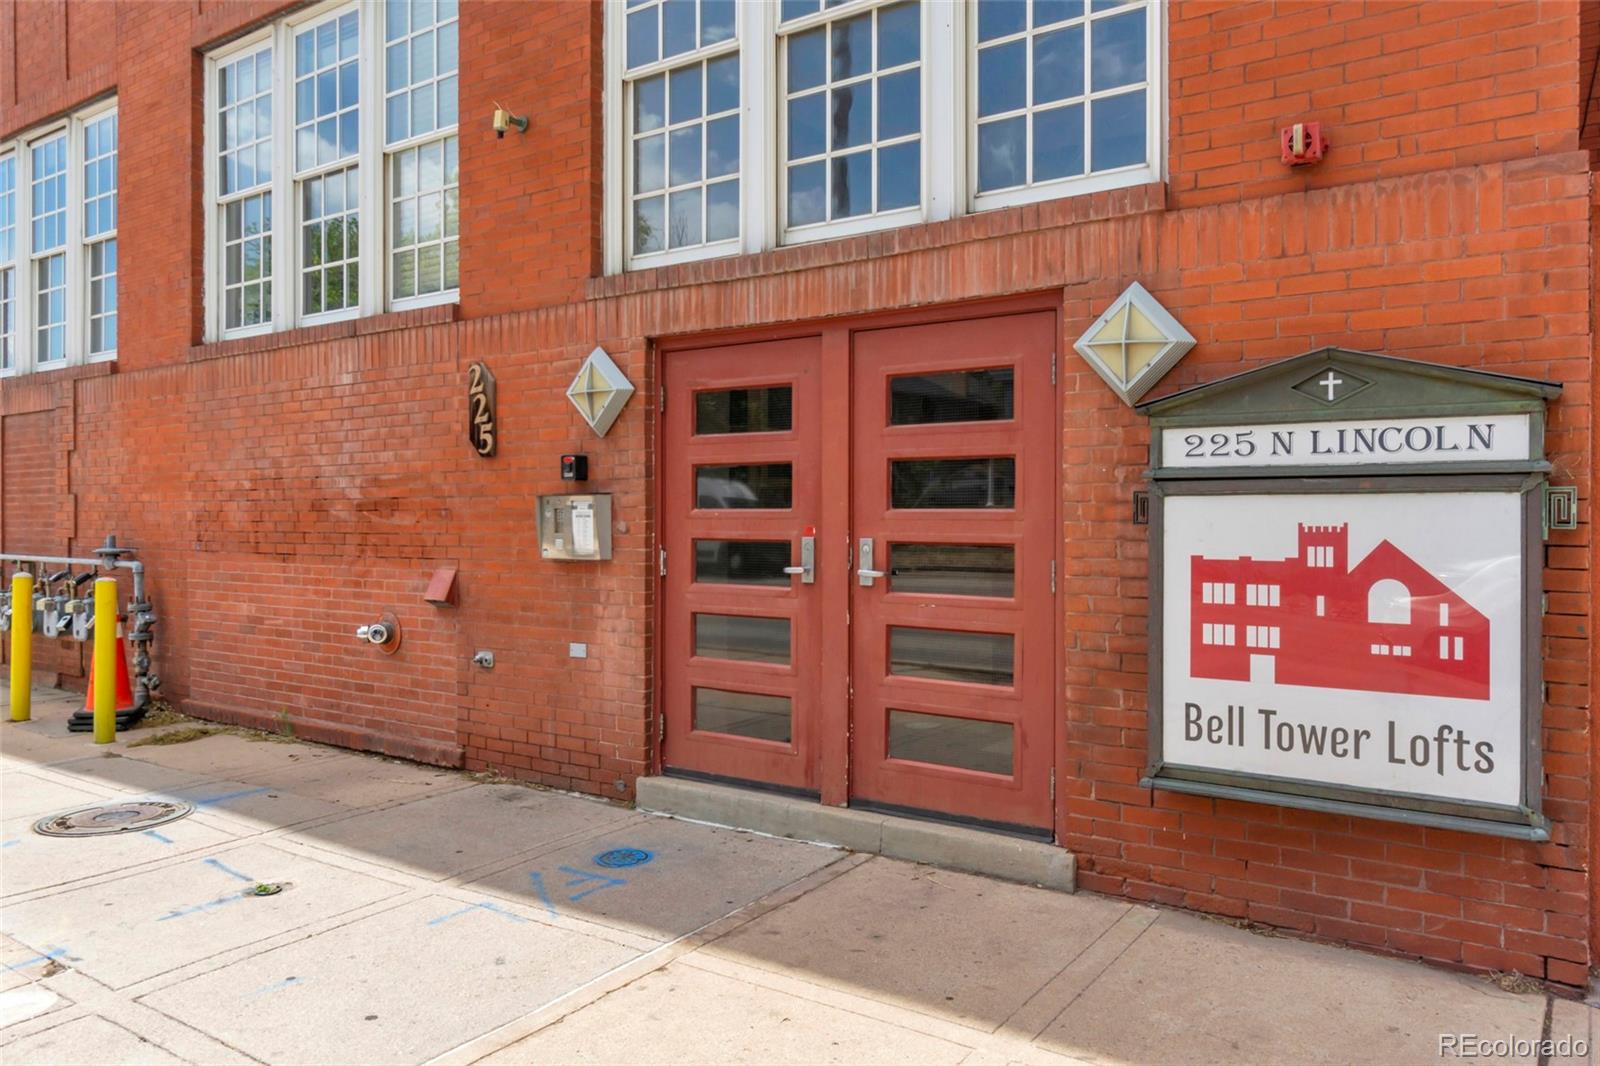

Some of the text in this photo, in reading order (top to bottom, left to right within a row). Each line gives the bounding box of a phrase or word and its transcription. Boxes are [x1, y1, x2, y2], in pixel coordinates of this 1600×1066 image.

[468, 364, 493, 454] 225
[1184, 423, 1496, 458] 225 N LINCOLN
[1184, 702, 1495, 776] Bell Tower Lofts
